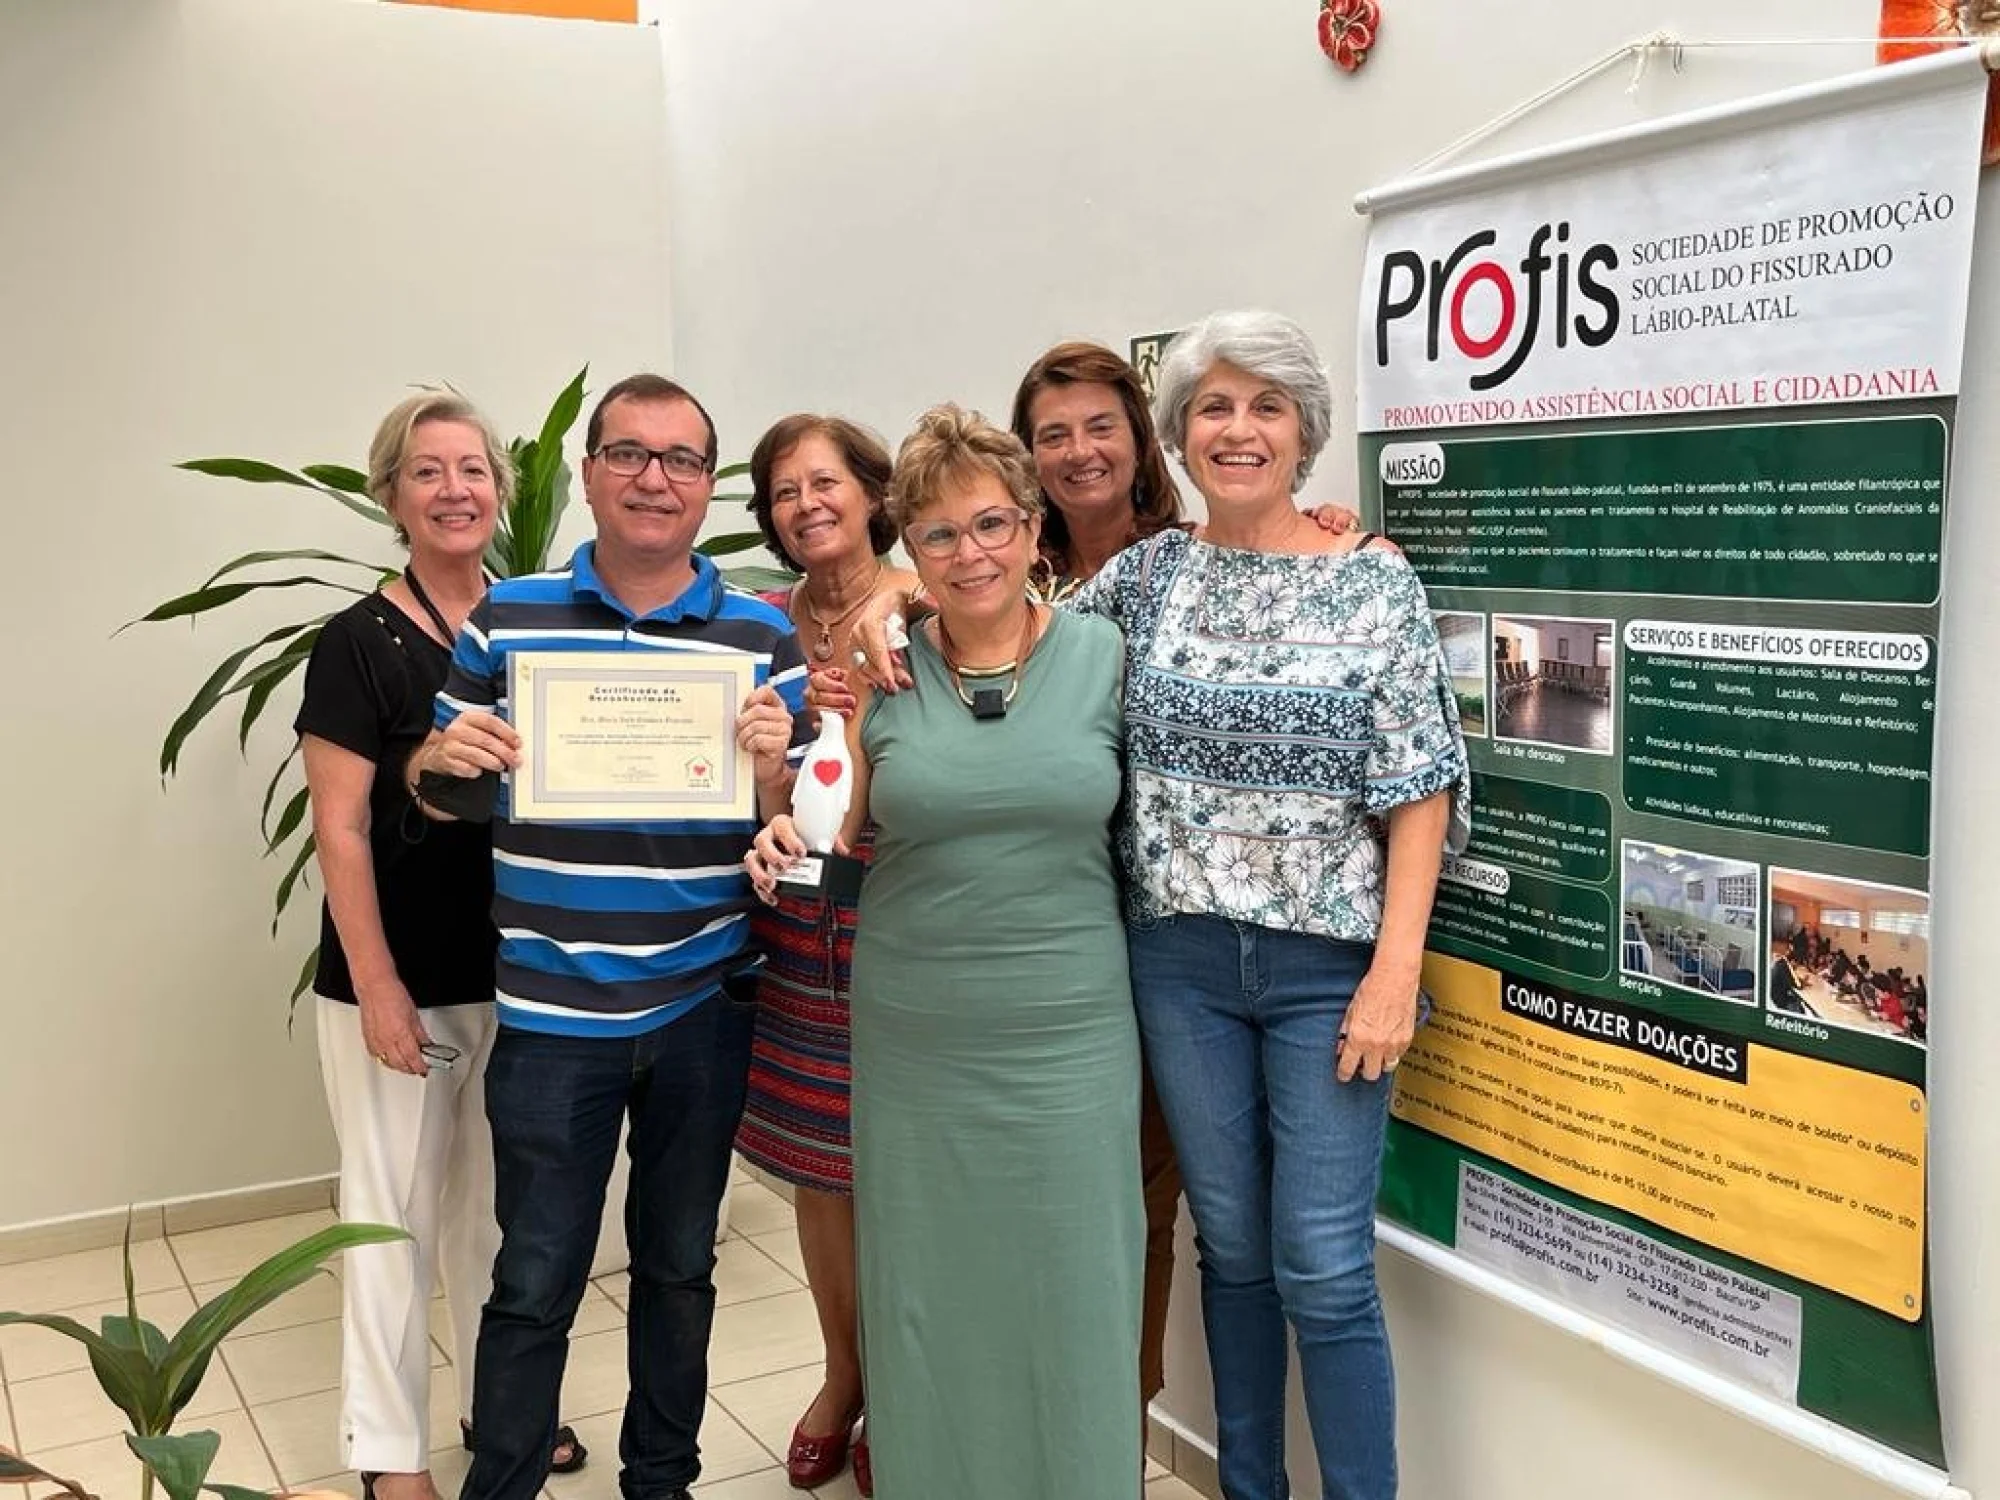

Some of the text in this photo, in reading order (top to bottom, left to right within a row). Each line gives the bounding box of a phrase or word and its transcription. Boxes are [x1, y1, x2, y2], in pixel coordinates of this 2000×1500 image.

[1632, 192, 1954, 267] SOCIEDADE DE PROMOÇÃO
[1632, 243, 1893, 301] SOCIAL DO FISSURADO
[1632, 294, 1798, 335] LÁBIO-PALATAL
[1384, 367, 1939, 429] PROMOVENDO ASSISTÊNCIA SOCIAL E CIDADANIA
[1386, 454, 1442, 481] MISSÃO
[1699, 482, 1737, 493] setembro
[1738, 482, 1750, 492] de
[1787, 482, 1808, 492] uma
[1810, 480, 1856, 492] entidade
[1858, 478, 1920, 492] filantrópica
[1922, 479, 1941, 492] que
[1672, 504, 1703, 517] Hospital
[1707, 504, 1720, 515] de
[1722, 504, 1776, 516] Reabilitação
[1781, 504, 1794, 514] de
[1798, 504, 1849, 514] Anomalias
[1854, 502, 1922, 514] Craniofaciais
[1749, 548, 1762, 560] de
[1764, 549, 1786, 560] todo
[1788, 548, 1830, 562] cidadão,
[1834, 550, 1886, 562] sobretudo
[1888, 552, 1902, 561] no
[1906, 552, 1926, 563] que
[1928, 552, 1938, 562] se
[1630, 627, 1923, 662] SERVIÇOS E BENEFÍCIOS OFERECIDOS
[1820, 667, 1842, 680] Sala
[1845, 670, 1858, 682] de
[1860, 672, 1912, 686] Descanso,
[1840, 692, 1899, 708] Alojamento
[1786, 709, 1800, 721] de
[1801, 711, 1852, 726] Motoristas
[1855, 717, 1862, 727] e
[1493, 742, 1566, 764] Sala de descanso
[1808, 756, 1864, 774] transporte,
[1714, 809, 1762, 826] educativas
[1764, 816, 1771, 826] e
[1455, 862, 1507, 890] RECURSOS
[1619, 975, 1662, 998] Berçário
[1507, 984, 1738, 1073] COMO FAZER DOAÇÕES
[1765, 1012, 1830, 1040] Refeitório
[1704, 1094, 1720, 1106] ser
[1722, 1098, 1746, 1115] feita
[1750, 1106, 1766, 1120] por
[1769, 1113, 1794, 1128] meio
[1797, 1122, 1811, 1134] de
[1857, 1138, 1872, 1151] ou
[1874, 1142, 1919, 1167] depósito
[1611, 1173, 1622, 1184] de
[1726, 1158, 1762, 1180] usuário
[1767, 1170, 1800, 1190] deverá
[1806, 1184, 1844, 1204] acessar
[1850, 1200, 1858, 1210] o
[1862, 1202, 1894, 1221] nosso
[1898, 1214, 1917, 1230] site
[1493, 1210, 1514, 1231] (14)
[1517, 1218, 1572, 1252] 3234-5699
[1574, 1248, 1586, 1260] ou
[1588, 1252, 1613, 1272] (14)
[1616, 1262, 1679, 1299] 3234-3258
[1542, 1201, 1554, 1213] de
[1556, 1206, 1602, 1234] Promoção
[1605, 1225, 1634, 1246] Social
[1650, 1244, 1696, 1272] Fissurado
[1732, 1276, 1771, 1302] Palatal
[1648, 1298, 1770, 1358] www.profis.com.br
